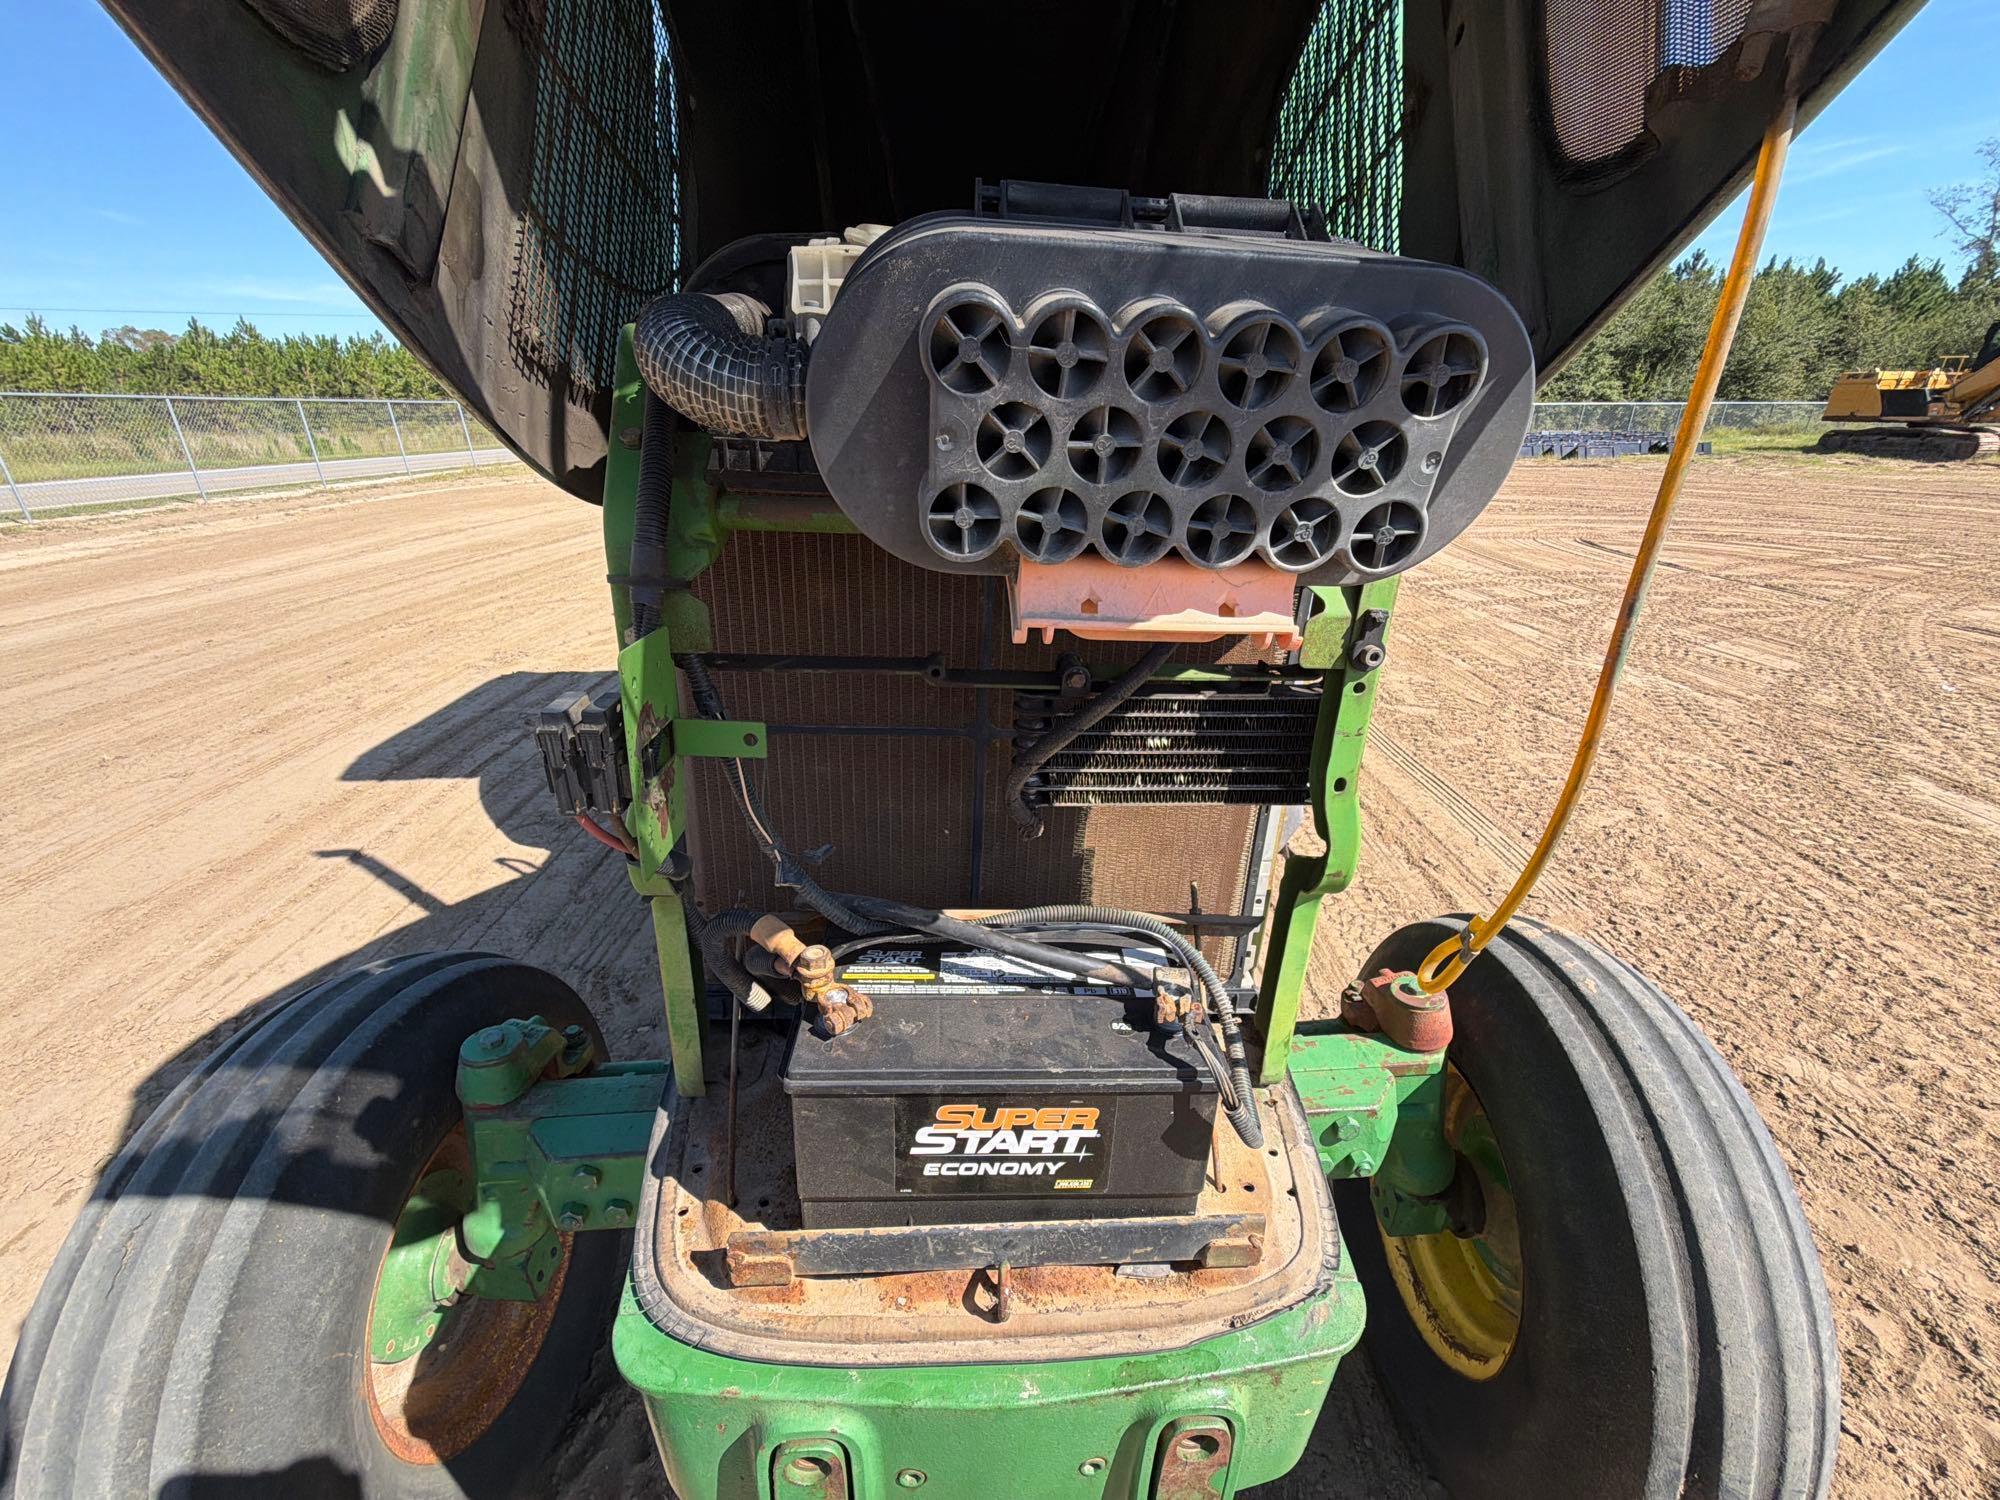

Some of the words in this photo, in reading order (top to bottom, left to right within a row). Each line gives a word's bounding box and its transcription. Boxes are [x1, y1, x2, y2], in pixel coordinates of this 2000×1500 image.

[856, 955, 923, 963] START
[866, 949, 923, 957] SUPER
[932, 1104, 1100, 1131] SUPER
[909, 1126, 1099, 1155] START
[923, 1161, 1067, 1176] ECONOMY
